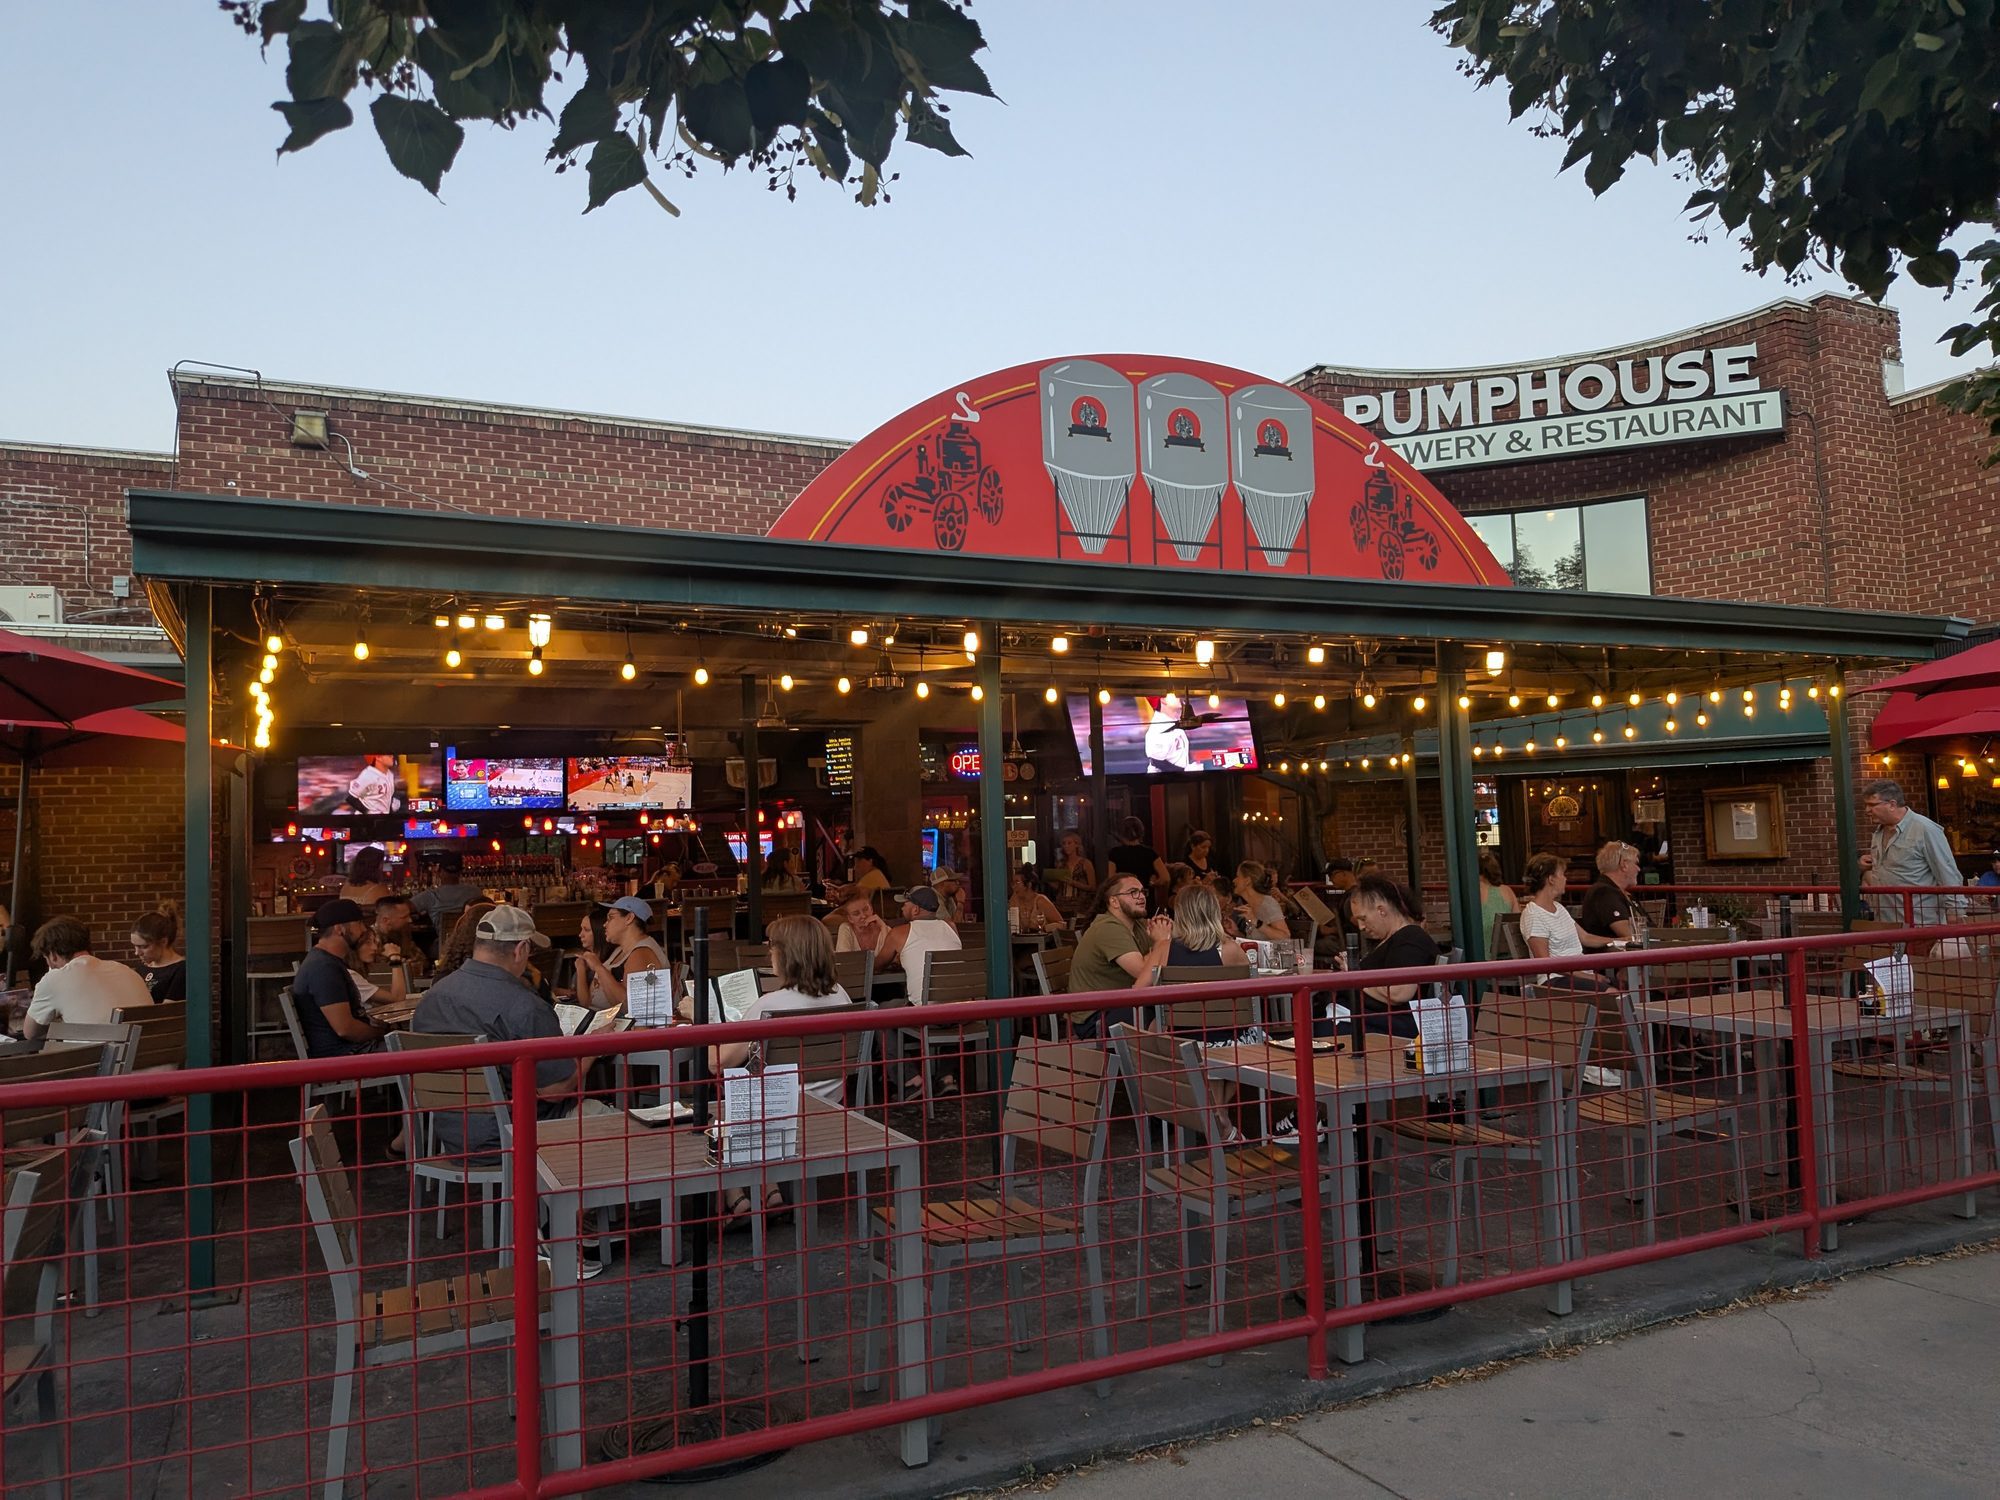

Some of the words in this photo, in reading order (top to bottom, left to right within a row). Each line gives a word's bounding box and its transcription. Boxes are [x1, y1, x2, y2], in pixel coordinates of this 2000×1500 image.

[1343, 342, 1760, 435] PUMPHOUSE
[1505, 430, 1532, 453] &
[1541, 400, 1767, 448] RESTAURANT
